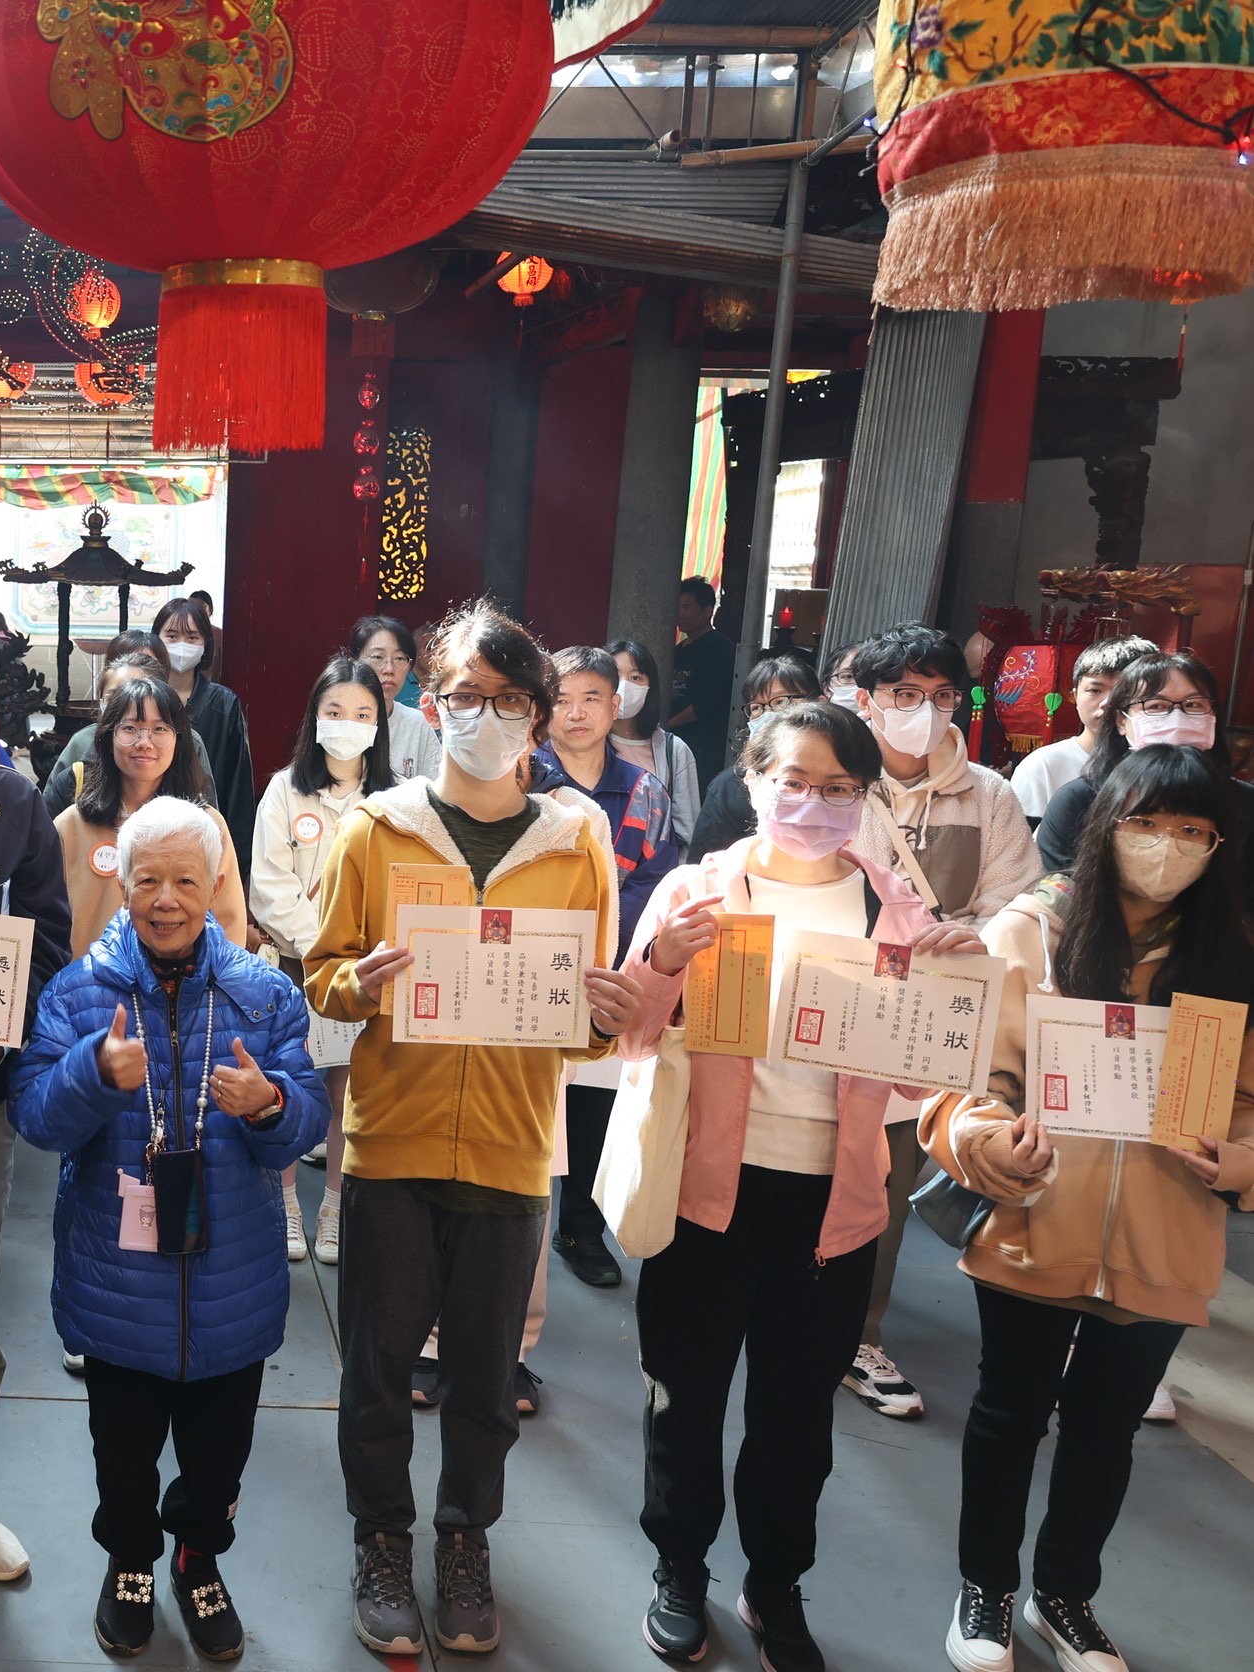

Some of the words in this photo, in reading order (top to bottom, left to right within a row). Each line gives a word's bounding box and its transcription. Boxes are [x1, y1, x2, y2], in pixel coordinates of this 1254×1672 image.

[486, 953, 495, 986] 以資鼓勵
[501, 952, 511, 1004] 獎學金及獎狀
[548, 953, 573, 1005] 獎狀
[875, 987, 888, 1021] 以資鼓勵
[890, 988, 905, 1041] 獎學金及獎狀
[943, 996, 975, 1050] 獎狀
[1113, 1047, 1123, 1081] 以資鼓勵
[1129, 1047, 1139, 1099] 獎學金及獎狀
